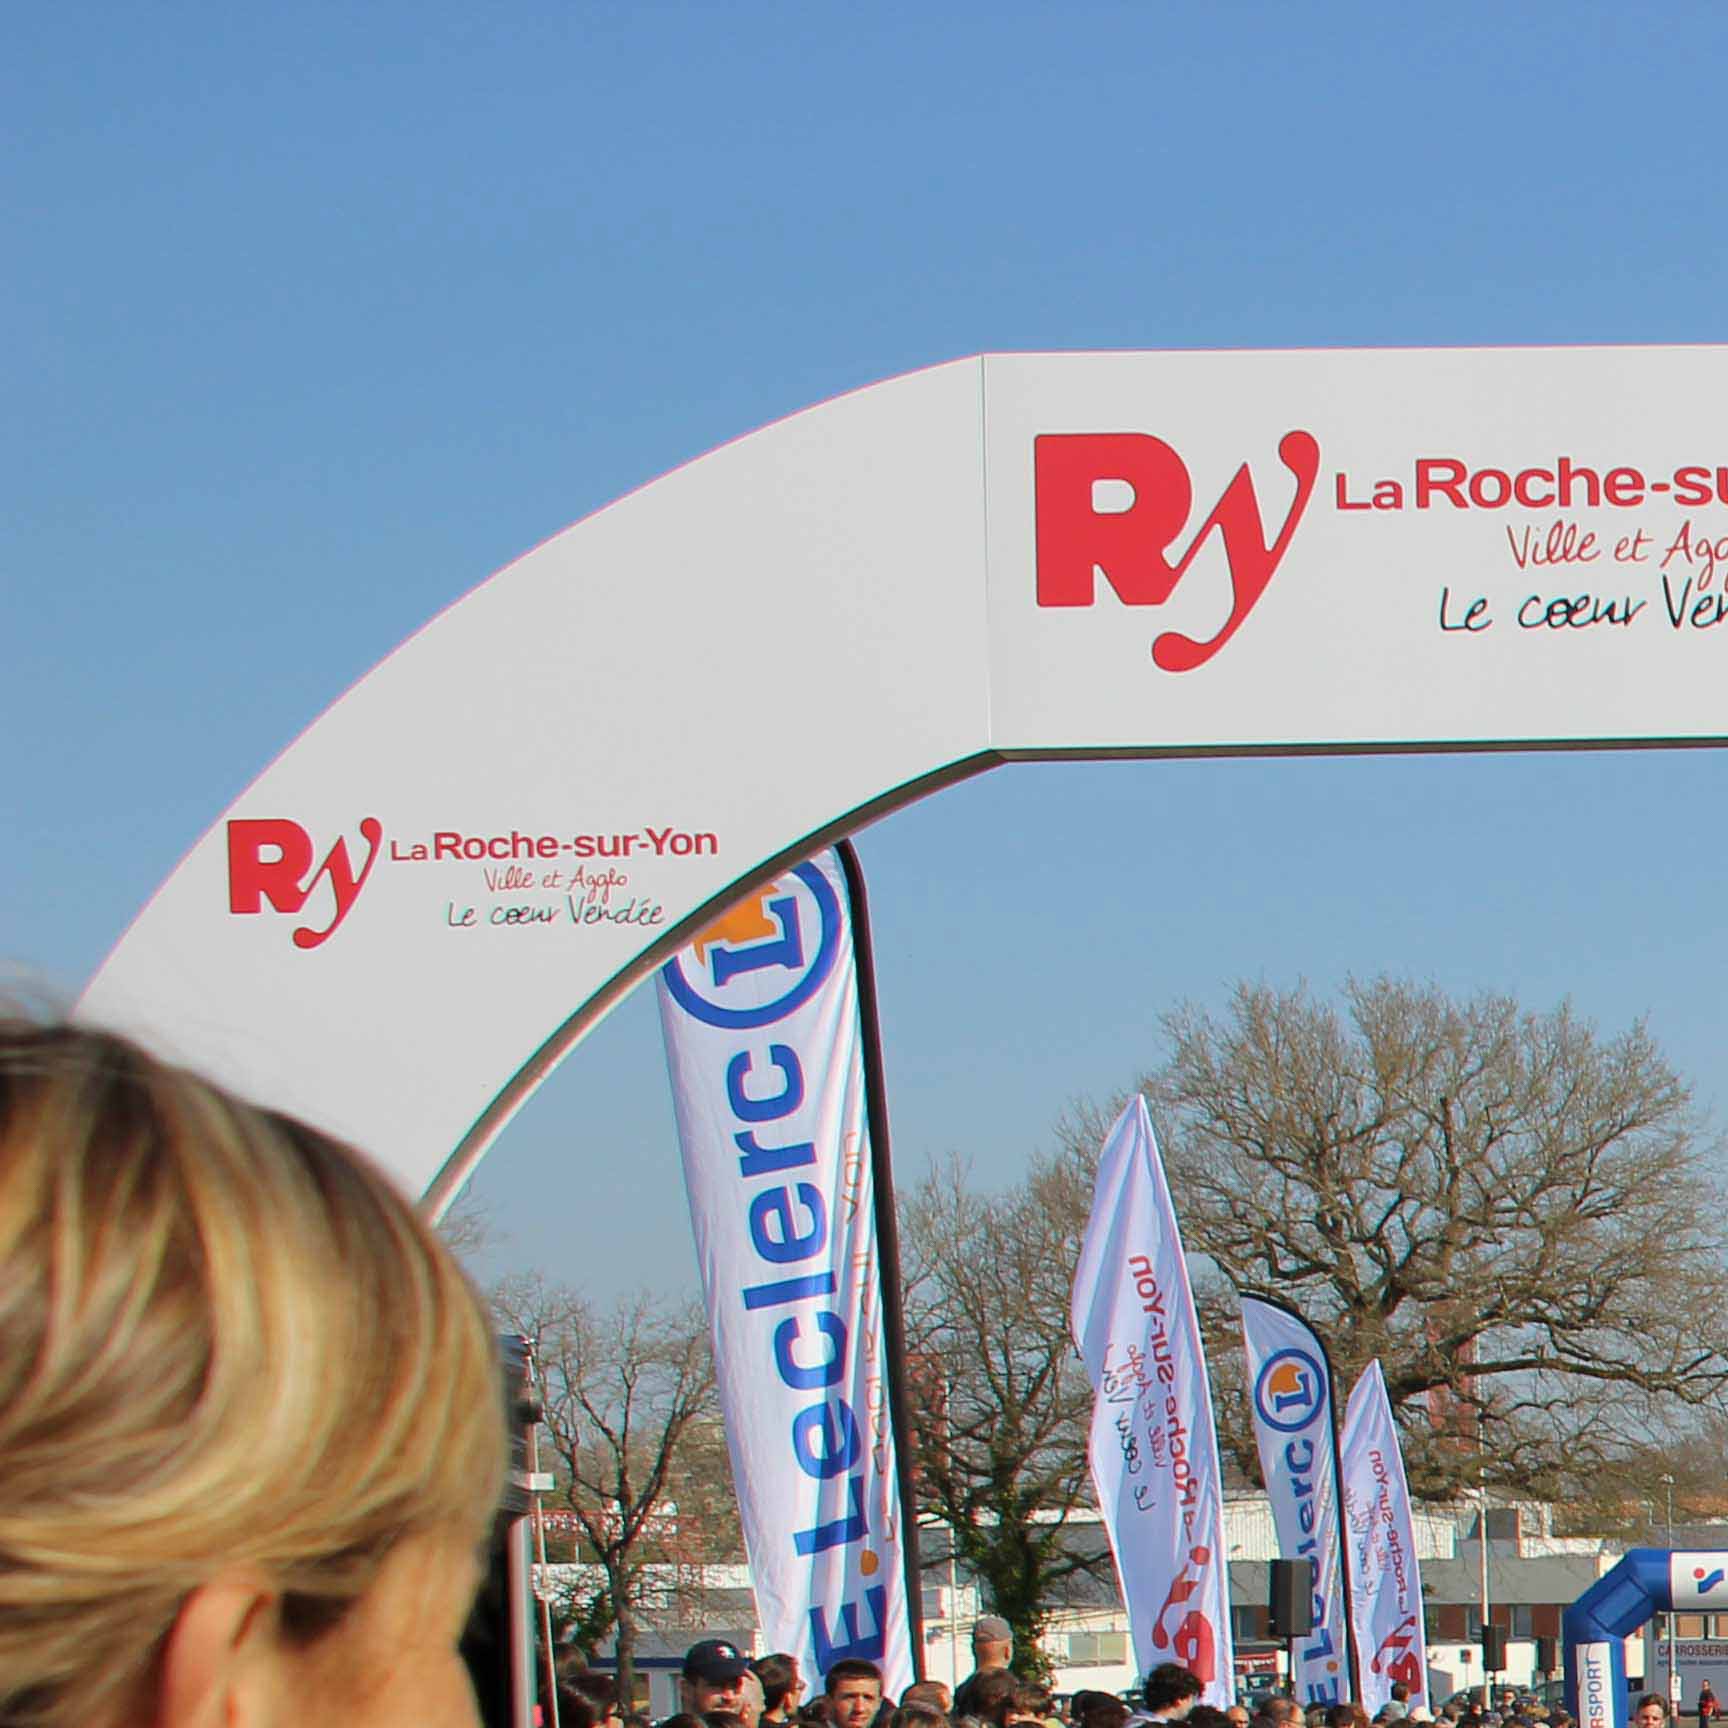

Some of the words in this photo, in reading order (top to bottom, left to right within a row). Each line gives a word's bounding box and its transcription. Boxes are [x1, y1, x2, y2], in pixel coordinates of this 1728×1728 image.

[1334, 473, 1403, 512] La
[1507, 522, 1601, 568] Ville
[1614, 532, 1655, 563] et
[1440, 584, 1493, 632] Le
[1519, 593, 1646, 631] cœur
[391, 840, 428, 861] La
[434, 827, 719, 860] Roche-sur-Yon
[484, 866, 535, 892] Ville
[542, 871, 564, 889] et
[568, 865, 628, 903] Agglo
[448, 901, 477, 927] Le
[490, 906, 559, 926] cœur
[568, 895, 665, 927] Vendée
